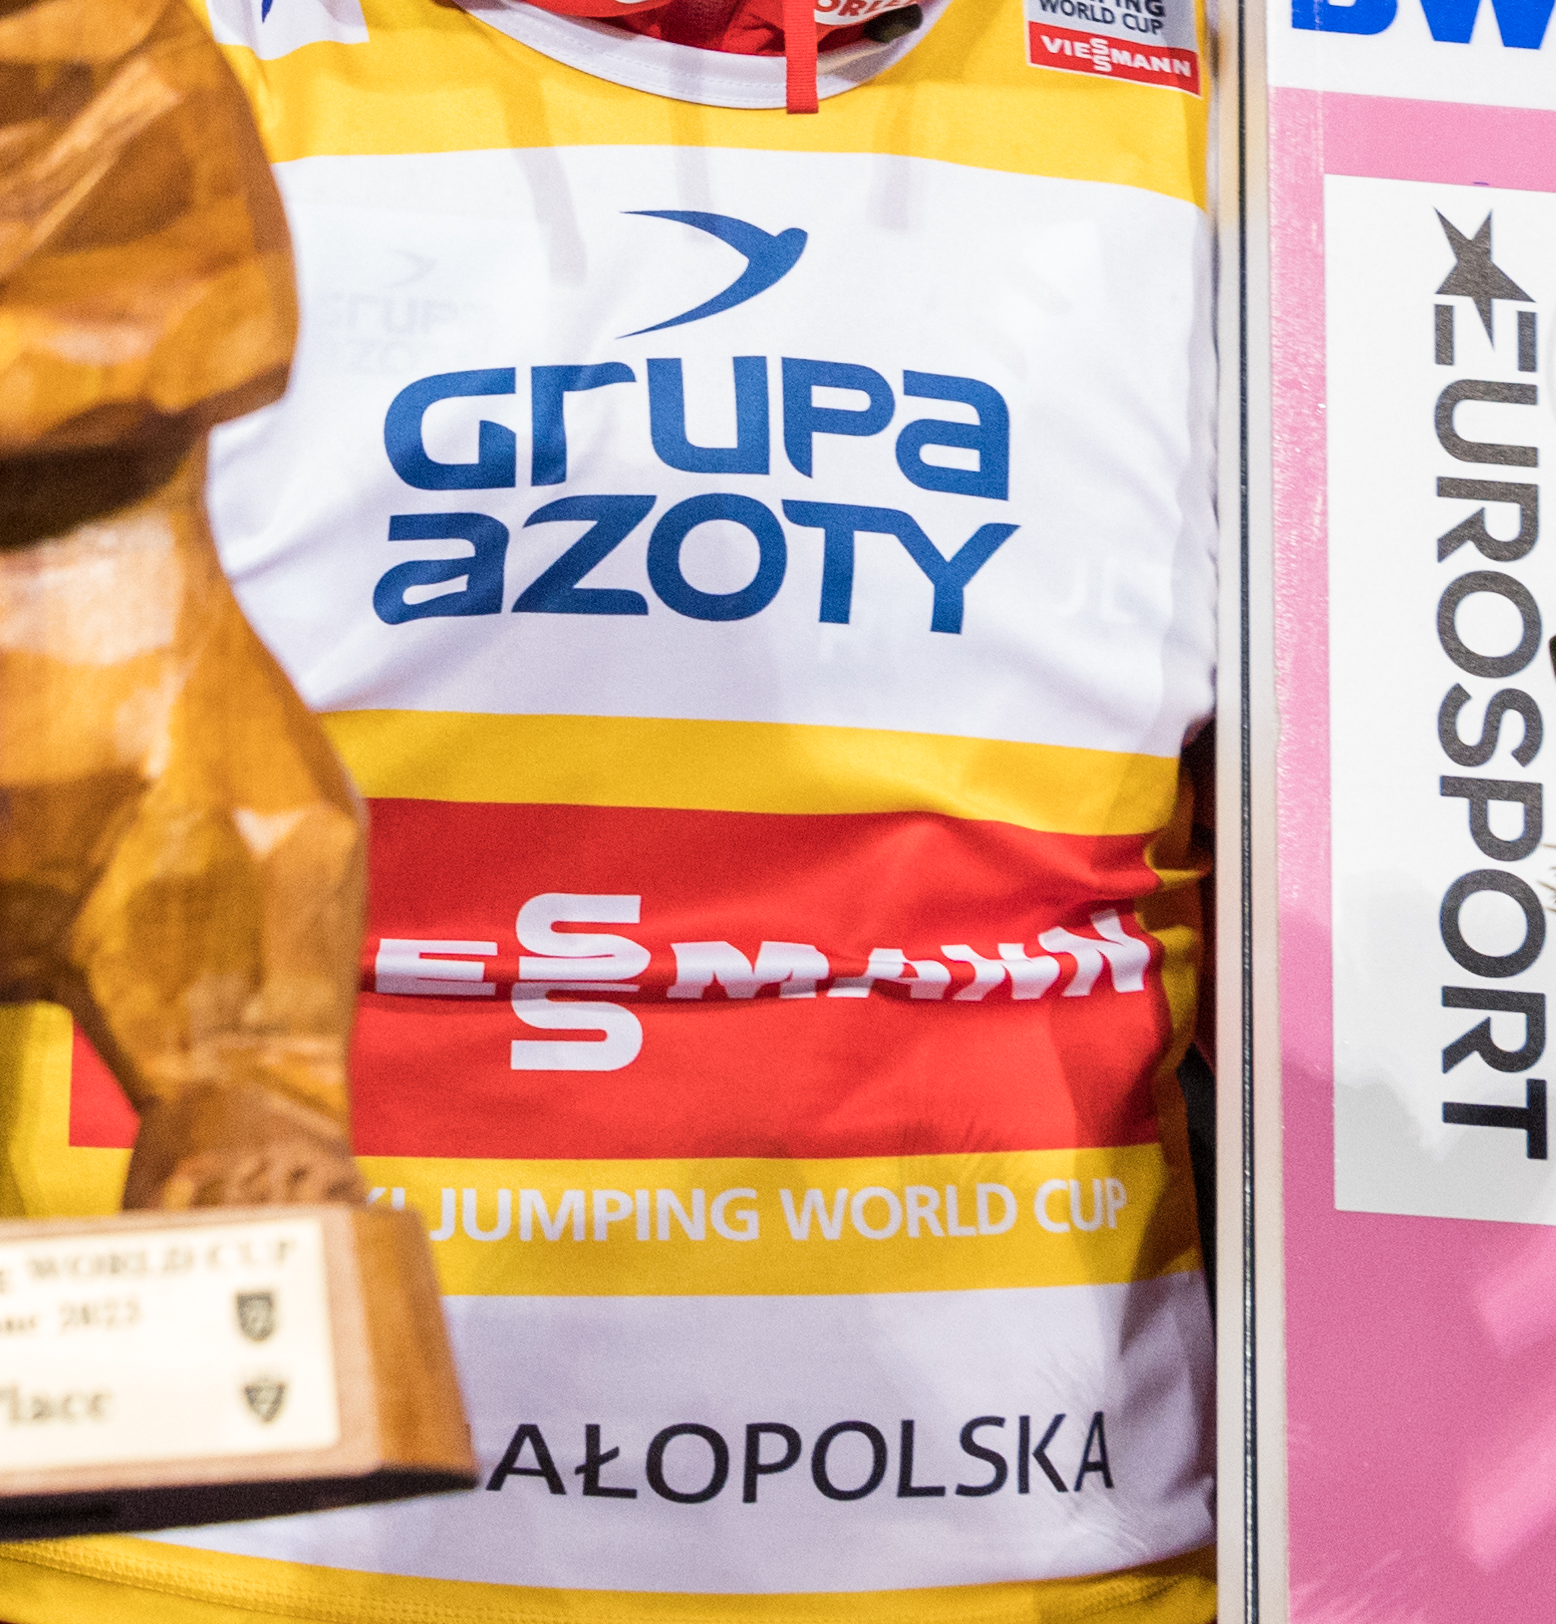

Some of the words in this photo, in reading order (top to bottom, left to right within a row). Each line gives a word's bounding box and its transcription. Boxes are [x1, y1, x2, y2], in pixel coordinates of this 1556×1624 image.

[1122, 13, 1164, 35] CUP
[1434, 302, 1549, 1160] EUROSPORT
[375, 893, 1151, 1071] ESSMANN
[429, 1187, 760, 1242] JUMPING
[780, 1181, 1018, 1241] WORLD
[1033, 1177, 1128, 1234] CUP
[484, 1409, 1117, 1505] AŁOPOLSKA
